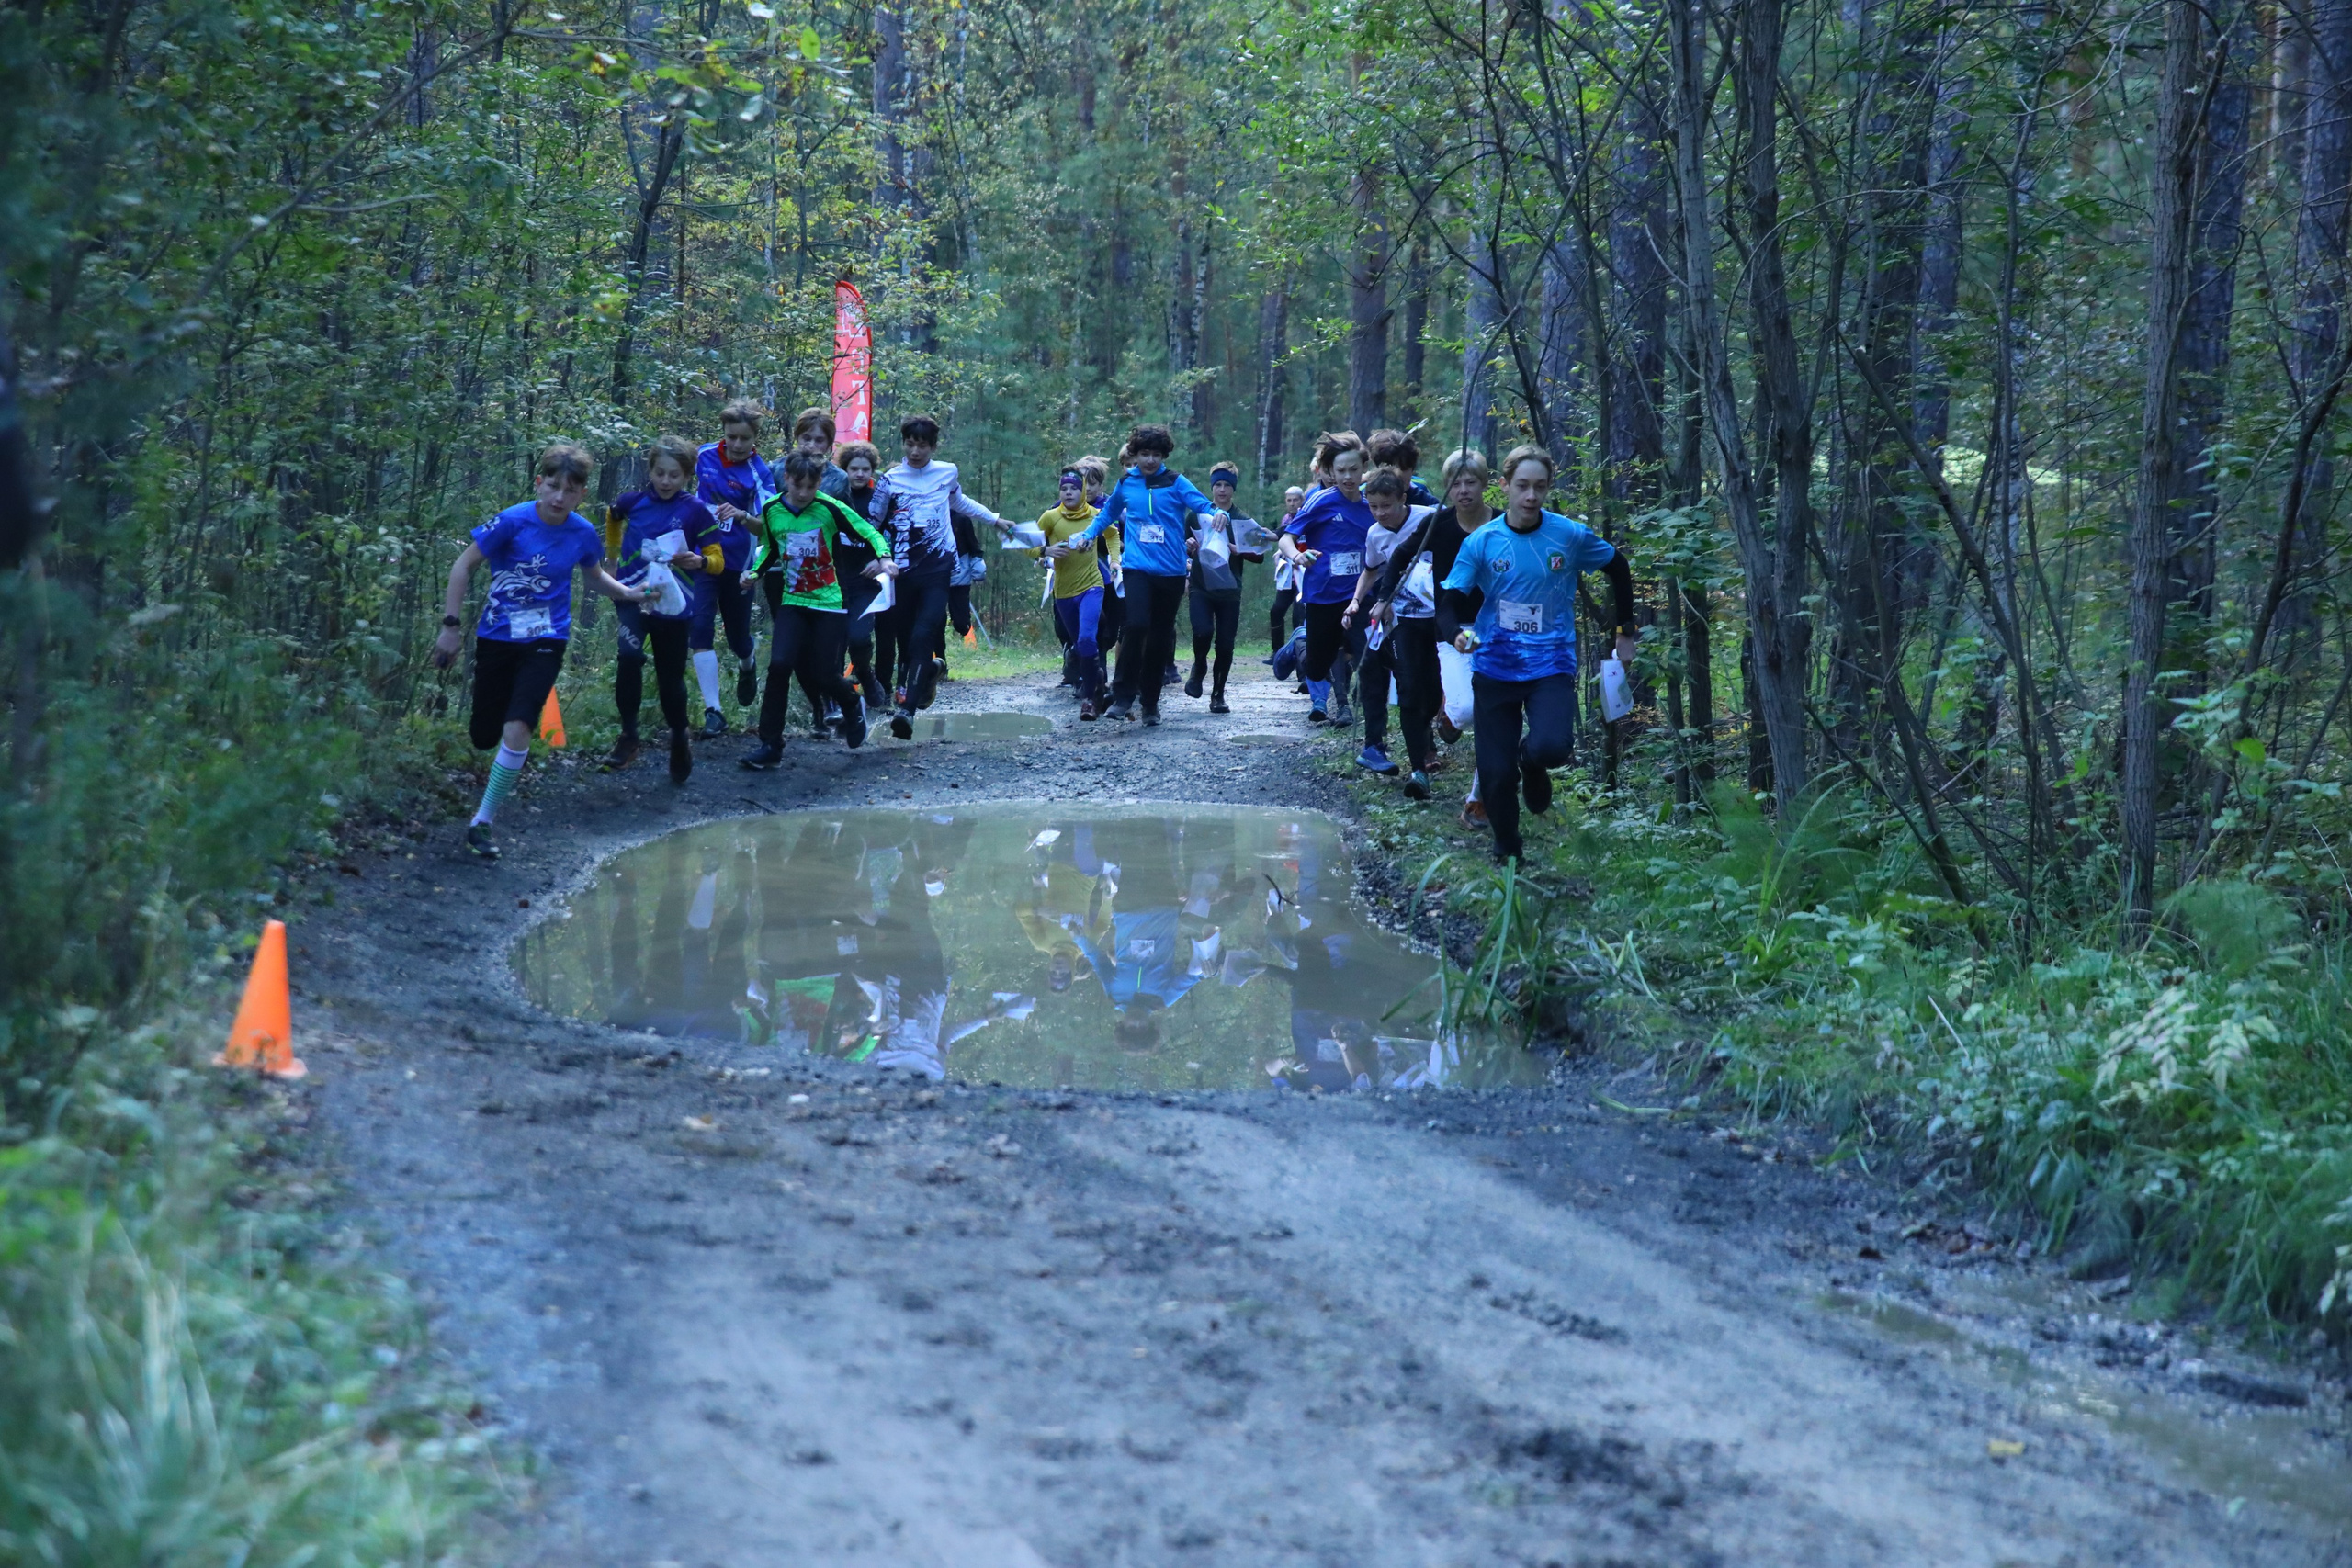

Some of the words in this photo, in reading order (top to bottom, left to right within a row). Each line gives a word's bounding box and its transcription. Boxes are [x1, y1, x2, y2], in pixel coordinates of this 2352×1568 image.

[926, 519, 941, 528] 325
[798, 547, 818, 557] 304
[1346, 565, 1359, 574] 311
[1514, 621, 1539, 634] 306
